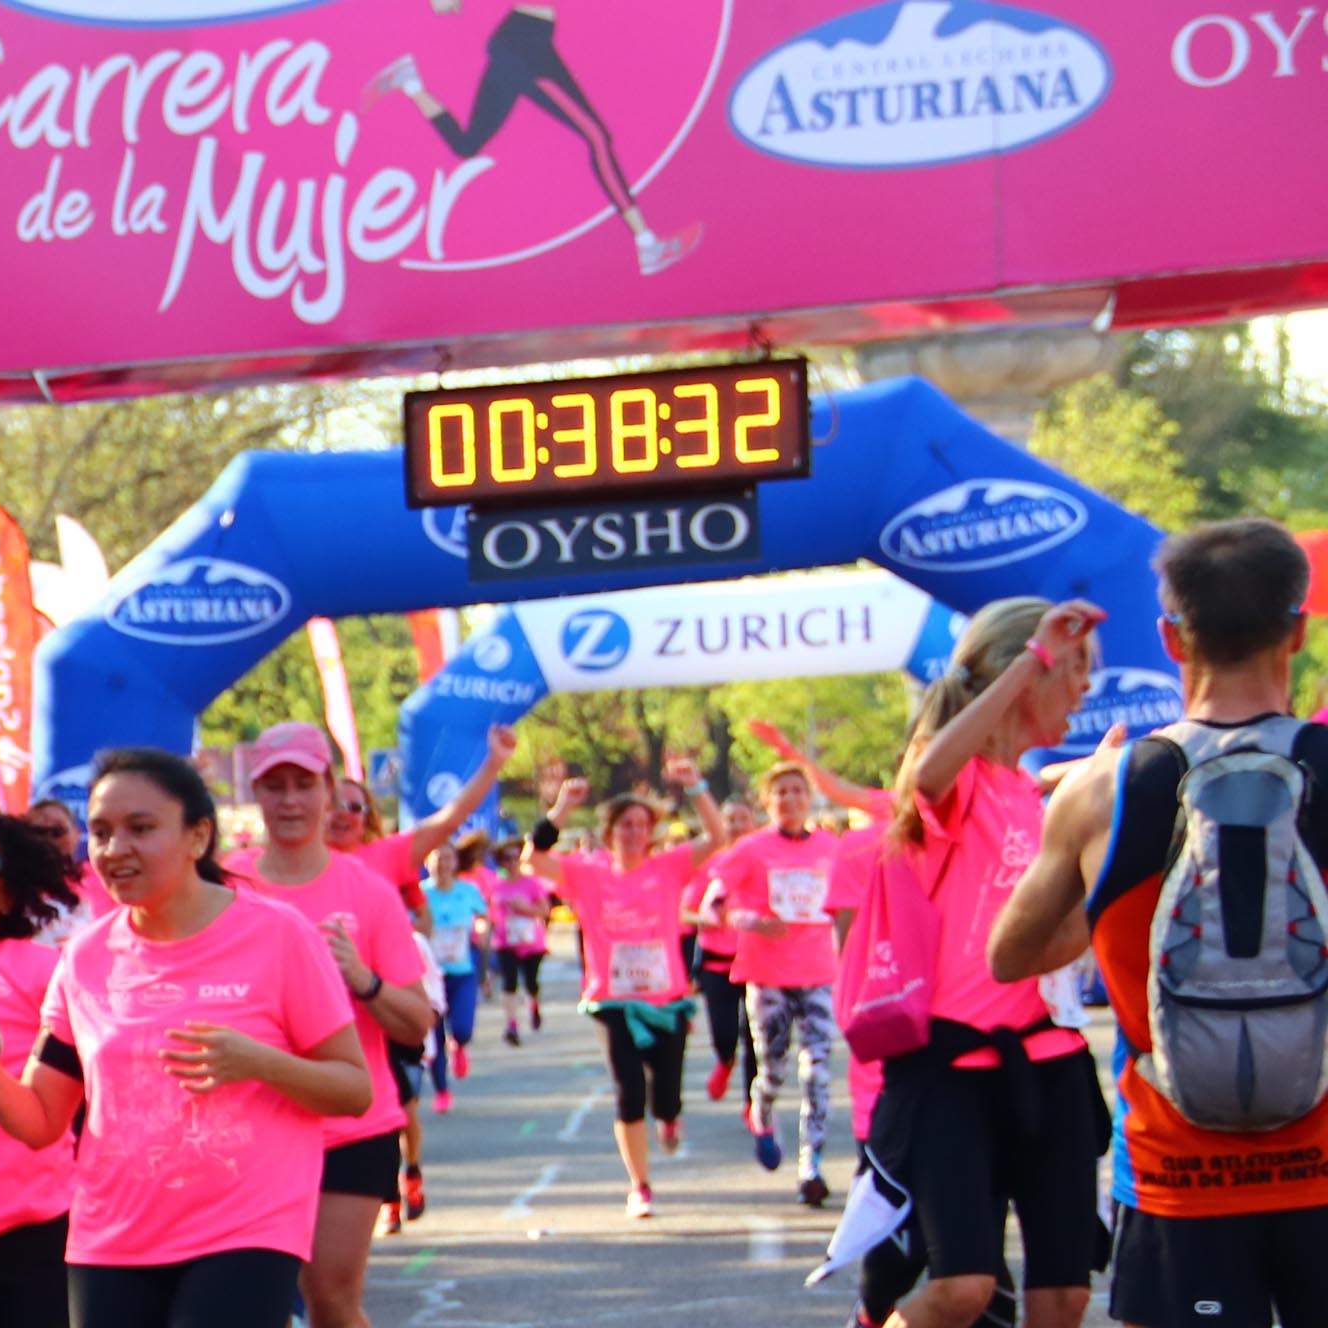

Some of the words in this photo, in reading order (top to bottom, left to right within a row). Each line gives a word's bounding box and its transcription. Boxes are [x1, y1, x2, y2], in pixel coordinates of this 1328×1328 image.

[1170, 5, 1328, 88] OY
[757, 66, 1083, 138] ASTURIANA
[16, 155, 94, 243] de
[111, 148, 168, 237] la
[156, 111, 496, 325] Mujer
[427, 376, 782, 488] 00:38:32
[482, 502, 750, 569] OYSHO
[898, 506, 1074, 557] ASTURIANA
[117, 594, 276, 623] ASTURIANA
[653, 604, 874, 658] ZURICH
[435, 673, 536, 705] ZURICH
[197, 983, 252, 998] DKV
